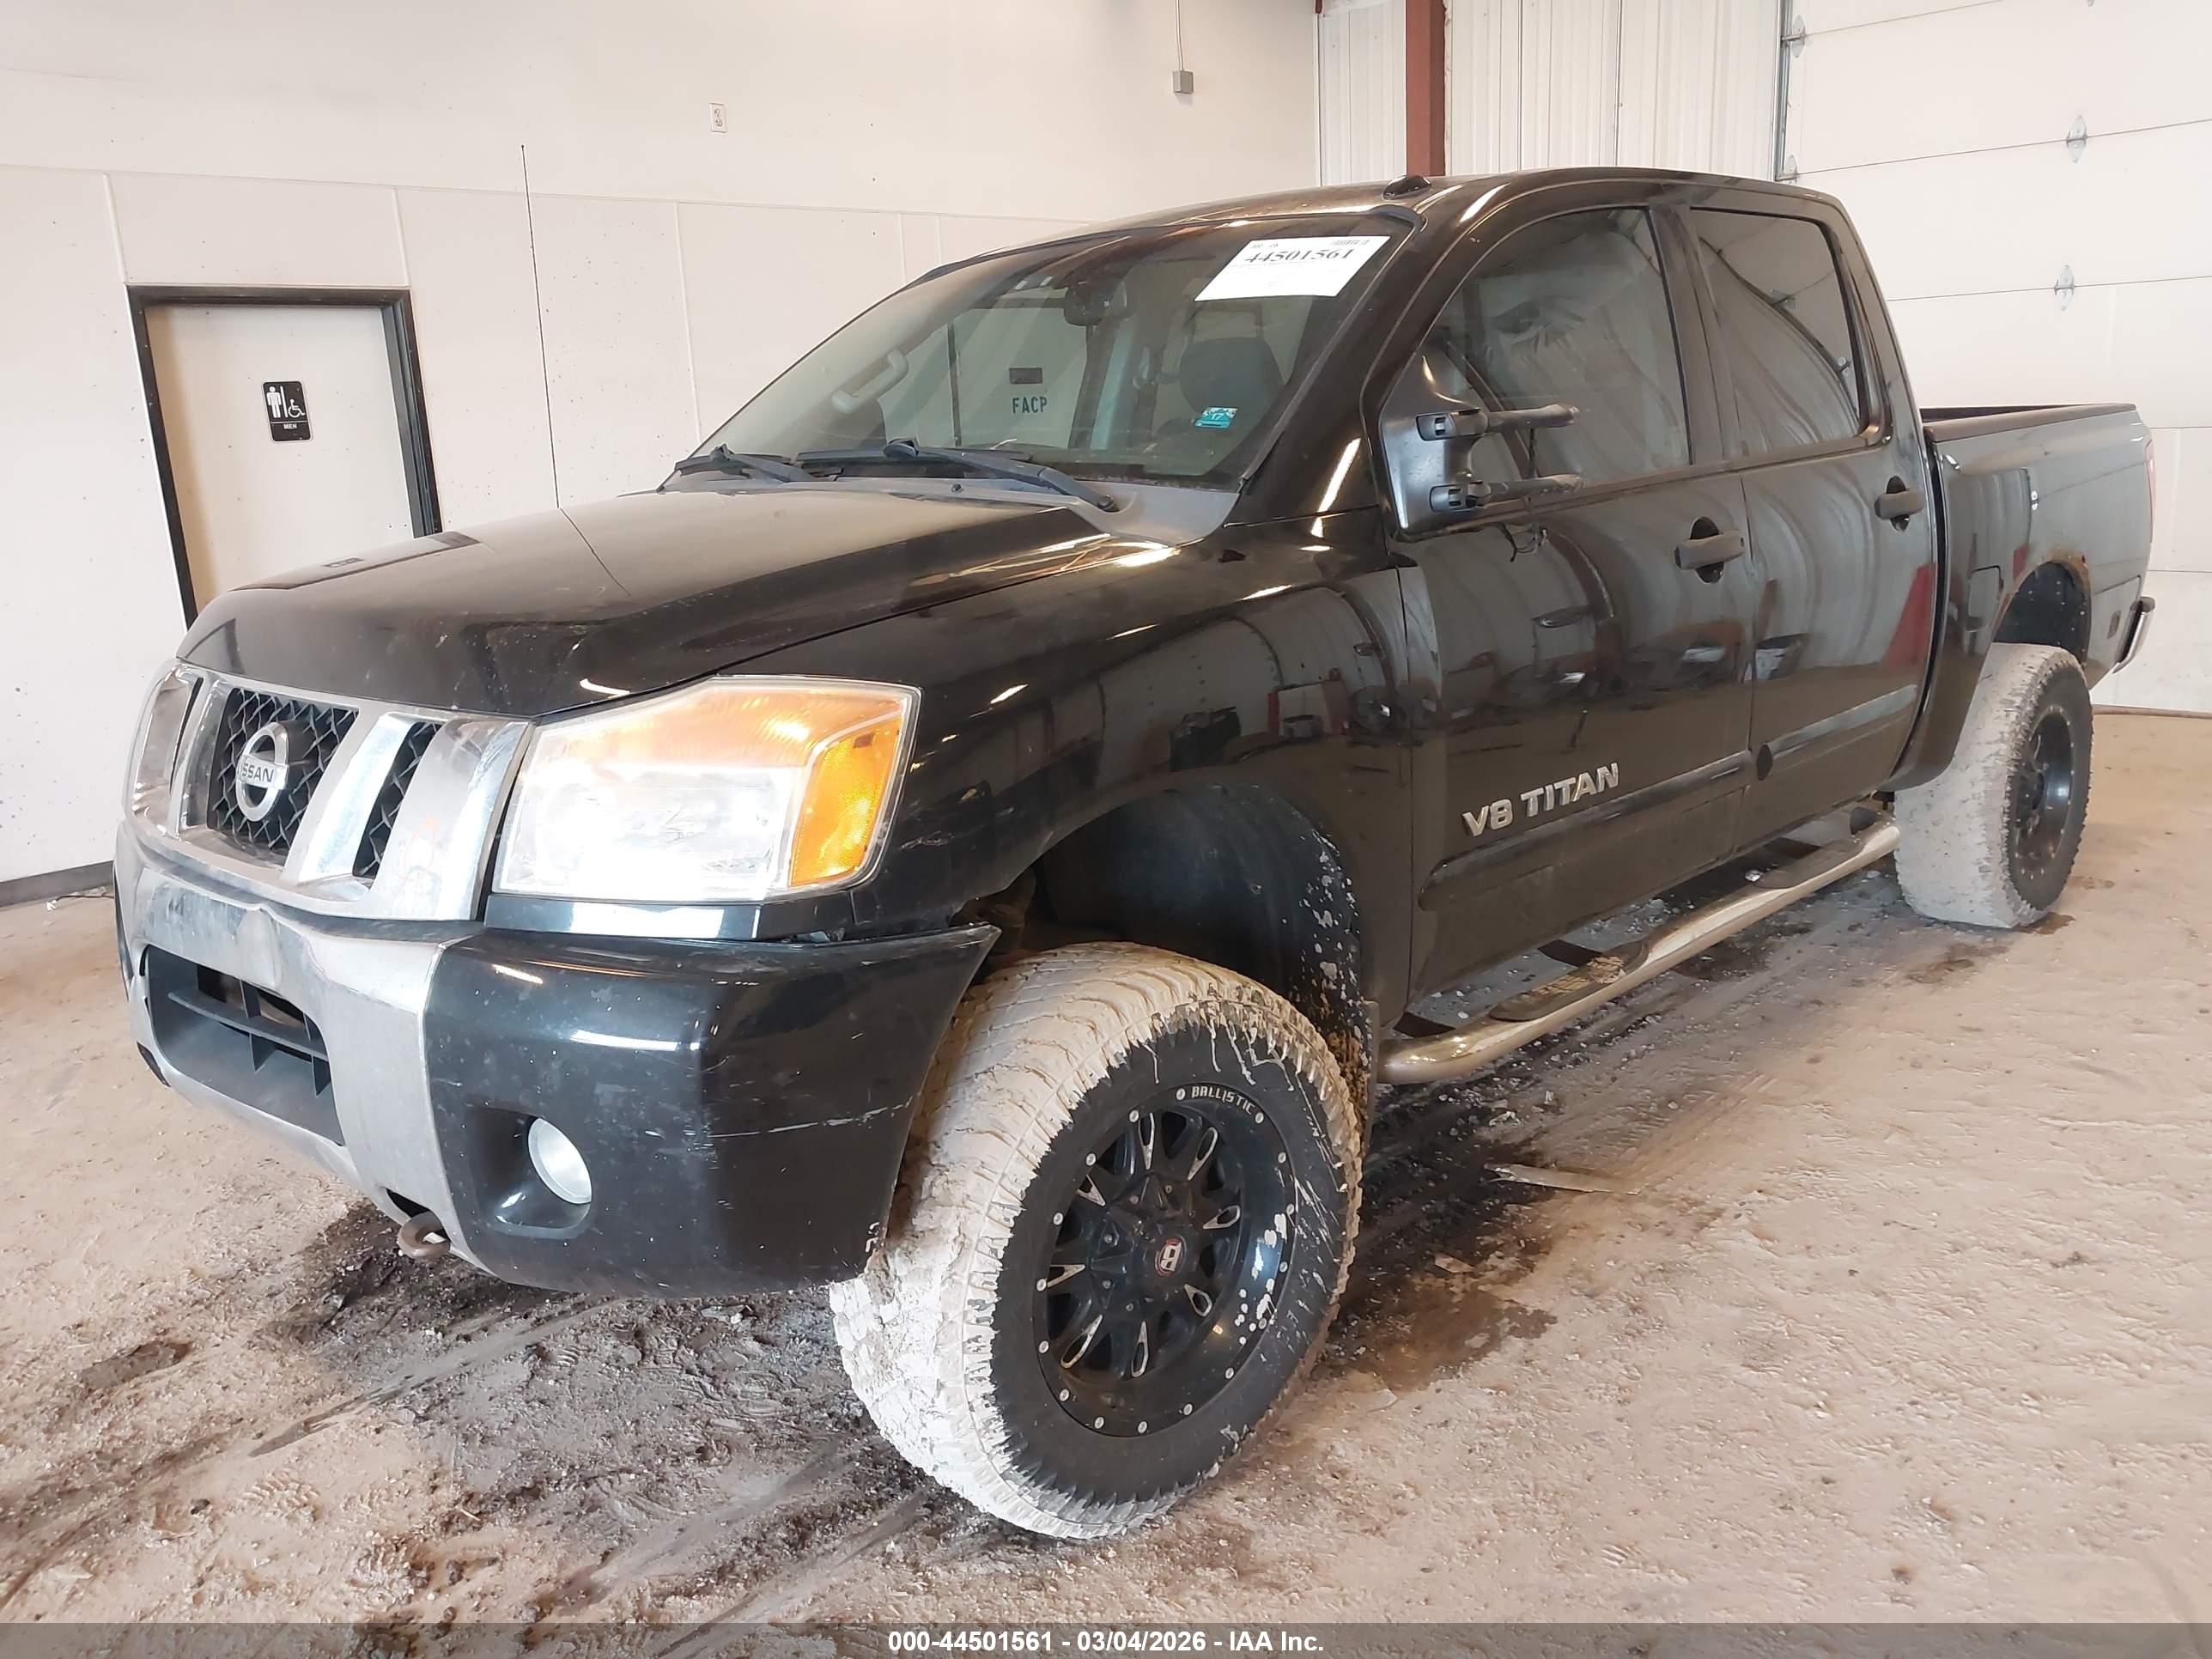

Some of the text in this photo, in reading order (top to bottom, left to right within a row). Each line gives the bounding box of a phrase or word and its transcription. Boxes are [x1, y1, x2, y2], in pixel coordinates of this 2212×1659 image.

[1245, 249, 1354, 263] 44501561
[1012, 396, 1048, 413] FACP
[1462, 763, 1619, 836] V8 TITAN
[1191, 1085, 1255, 1115] BALLISTIC
